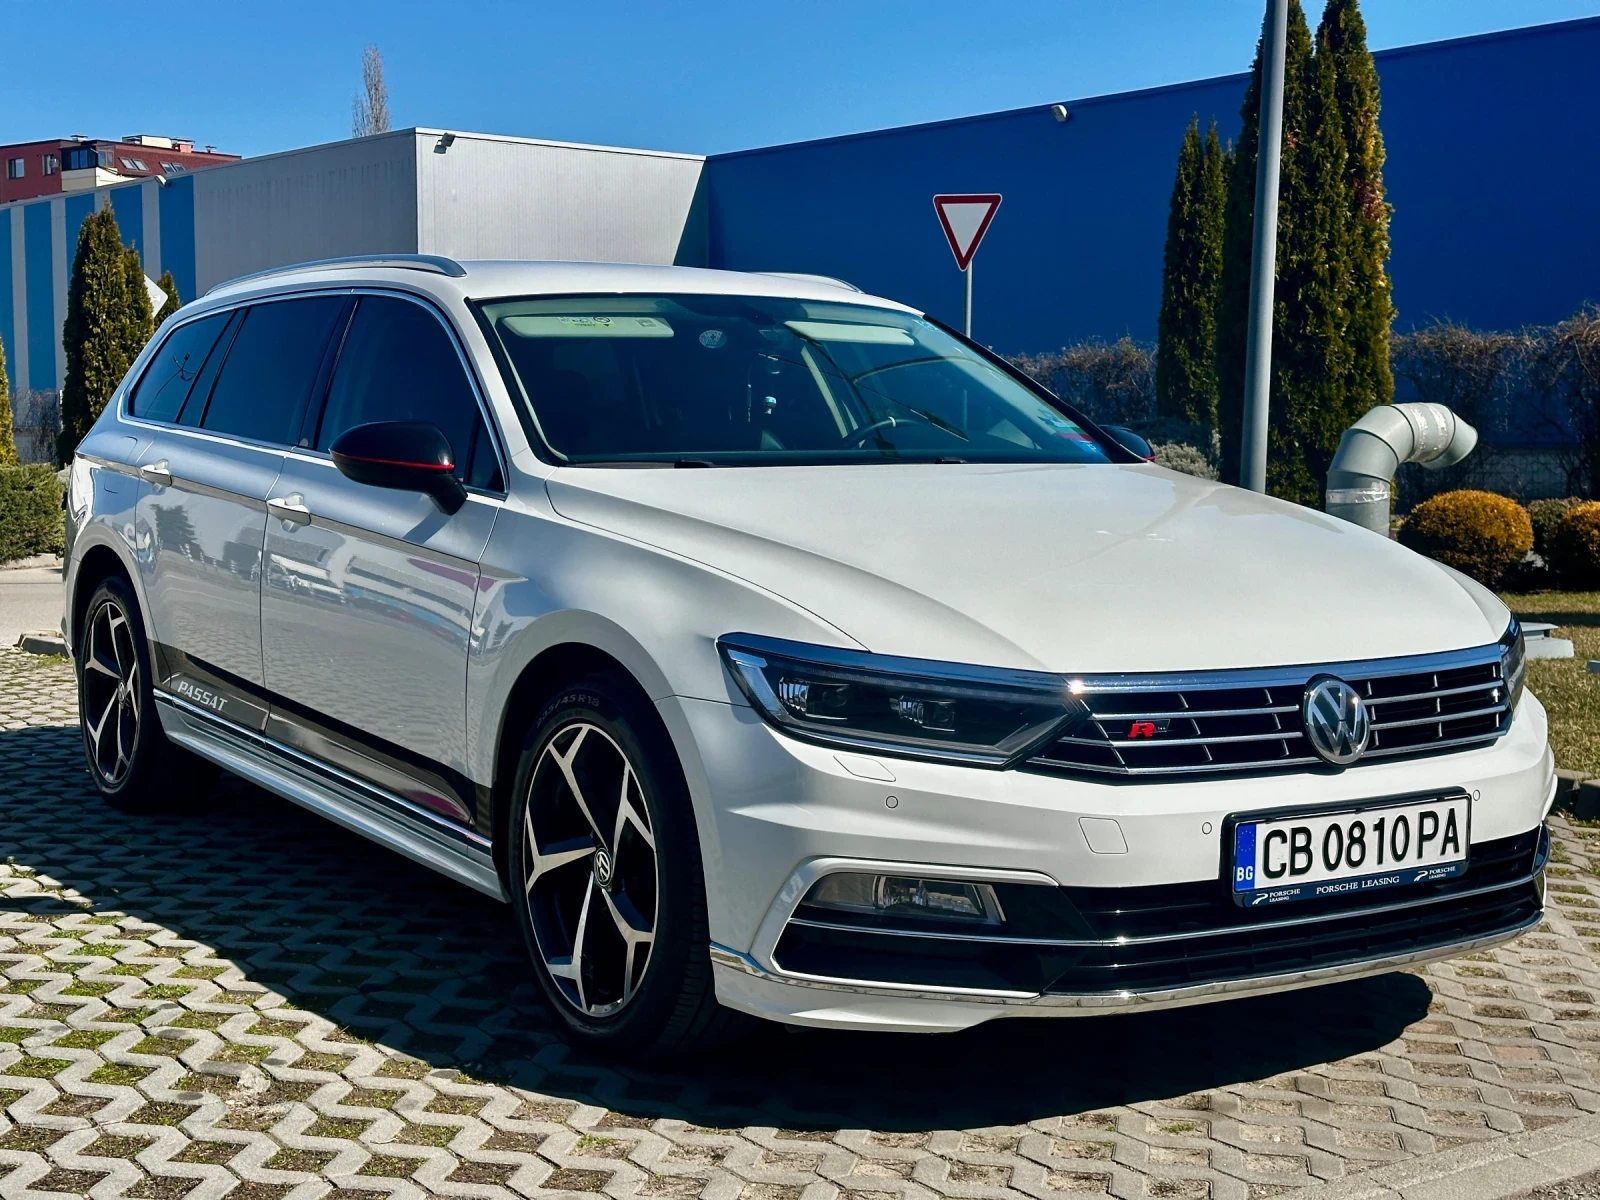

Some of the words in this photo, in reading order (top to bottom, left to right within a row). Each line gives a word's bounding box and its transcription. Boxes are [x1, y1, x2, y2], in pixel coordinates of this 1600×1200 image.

[177, 681, 228, 711] PASSAT
[1262, 826, 1314, 880] CB
[1322, 814, 1410, 872] 0810
[1416, 807, 1461, 860] PA
[1236, 865, 1254, 882] BG
[1429, 866, 1456, 875] PORSCHE
[1269, 888, 1301, 898] PORSCHE
[1316, 881, 1359, 895] PORSCHE
[1361, 876, 1401, 889] LEASING
